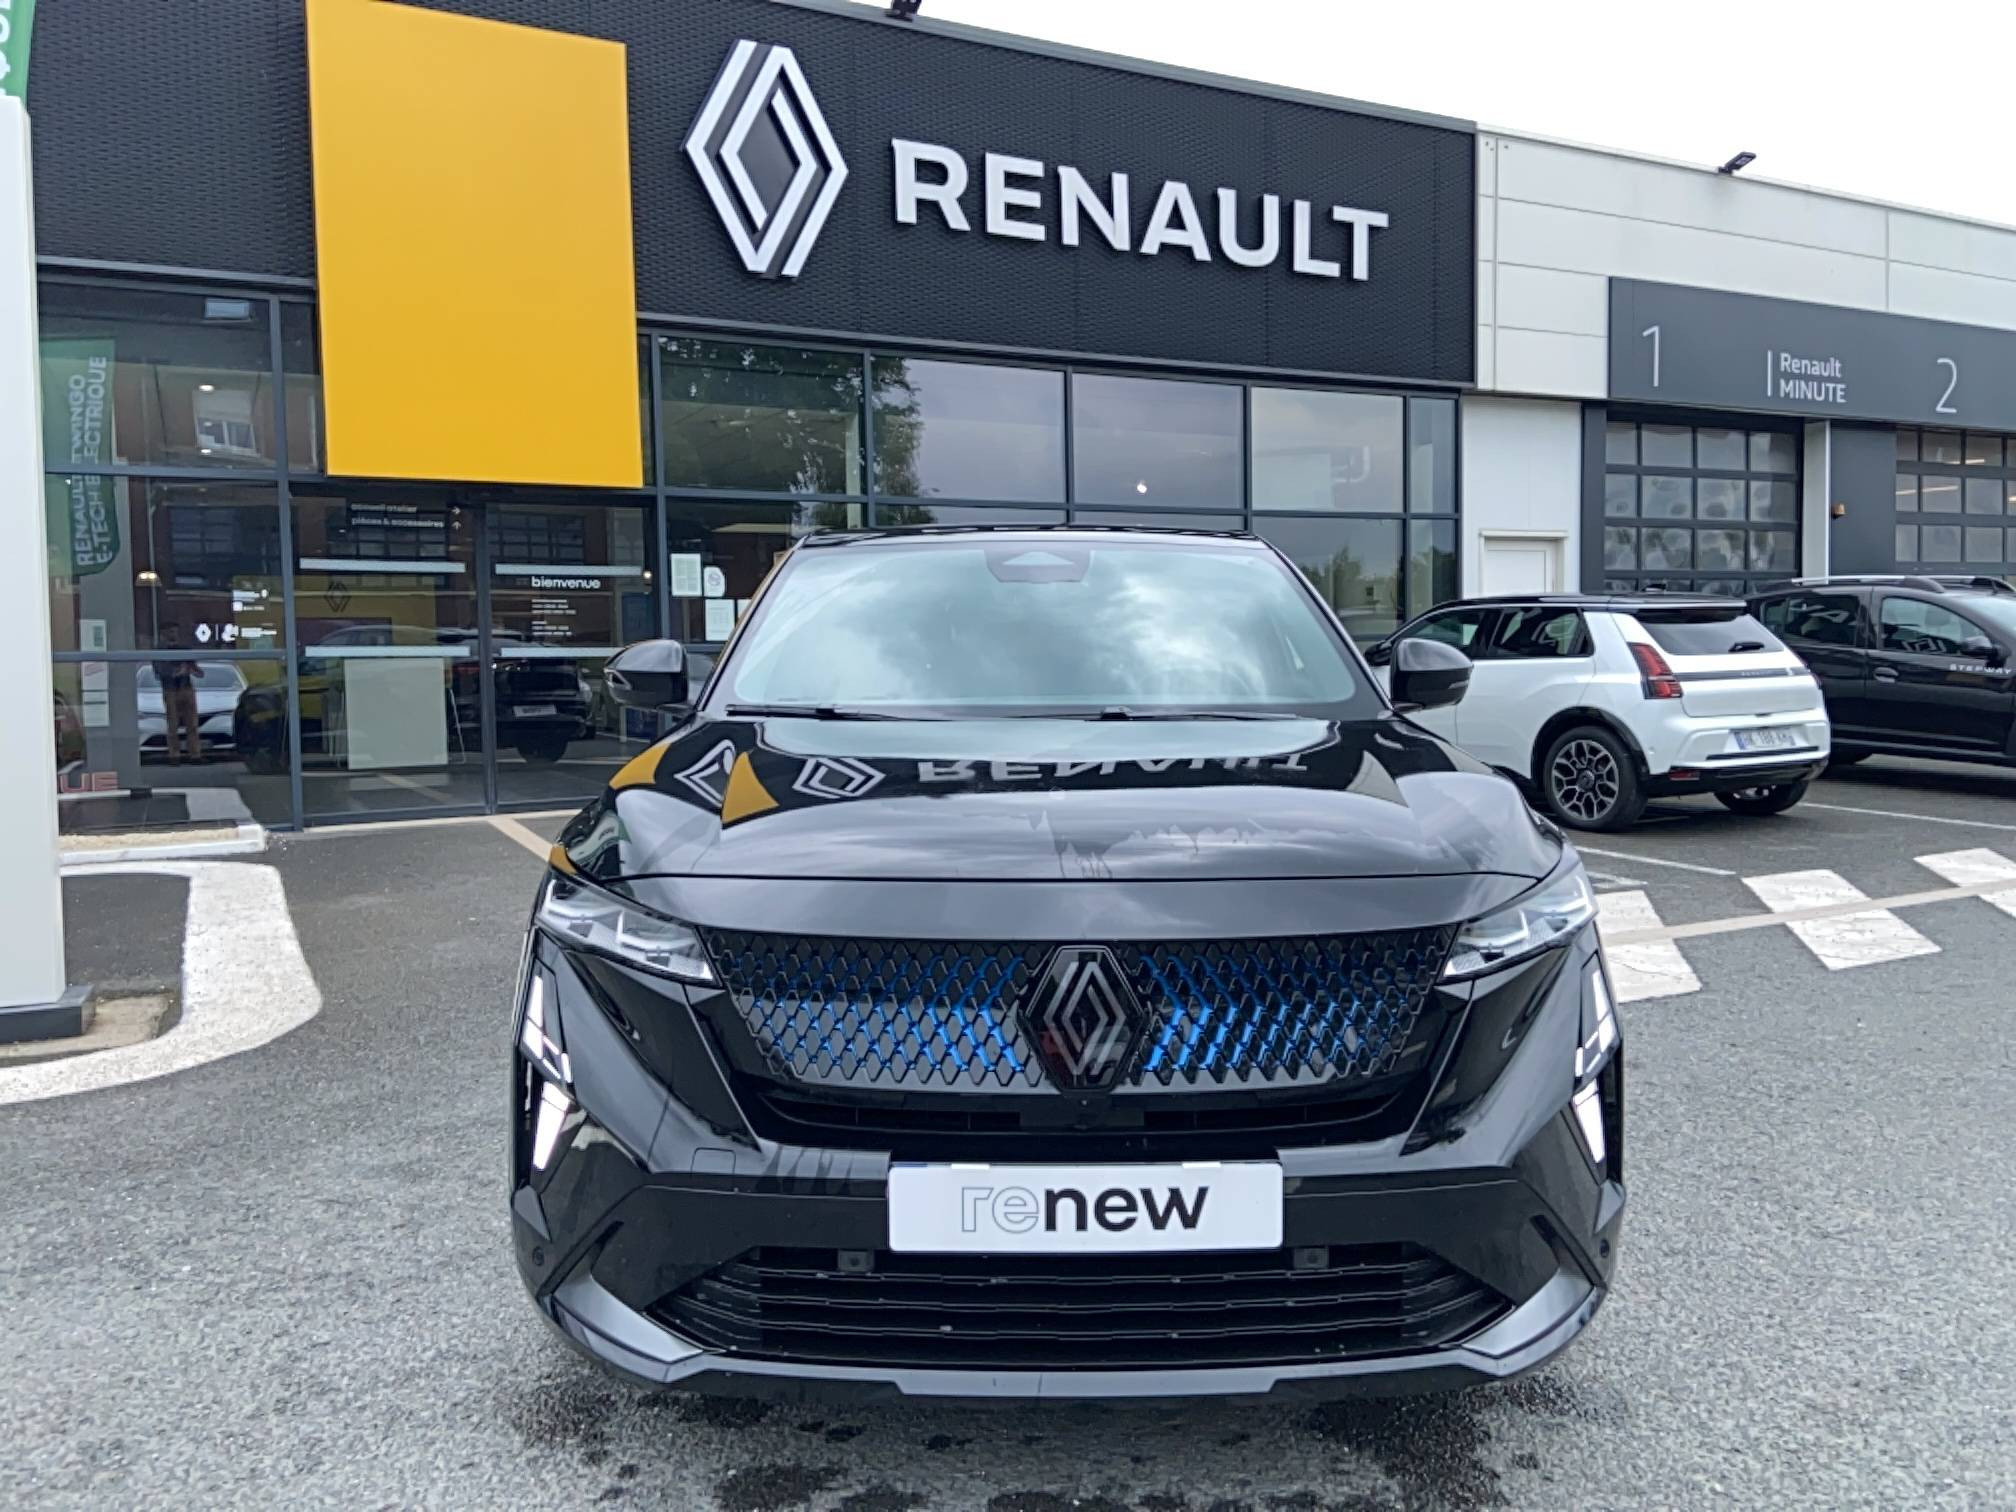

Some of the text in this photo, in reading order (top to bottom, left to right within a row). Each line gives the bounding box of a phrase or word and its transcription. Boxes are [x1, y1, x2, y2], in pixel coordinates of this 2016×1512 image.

[891, 138, 1389, 280] RENAULT
[1643, 325, 1660, 388] 1
[1779, 352, 1842, 378] Renault
[1779, 378, 1847, 403] MINUTE
[1935, 357, 1958, 414] 2
[530, 575, 601, 589] bienvenue
[961, 1185, 1210, 1234] renew
